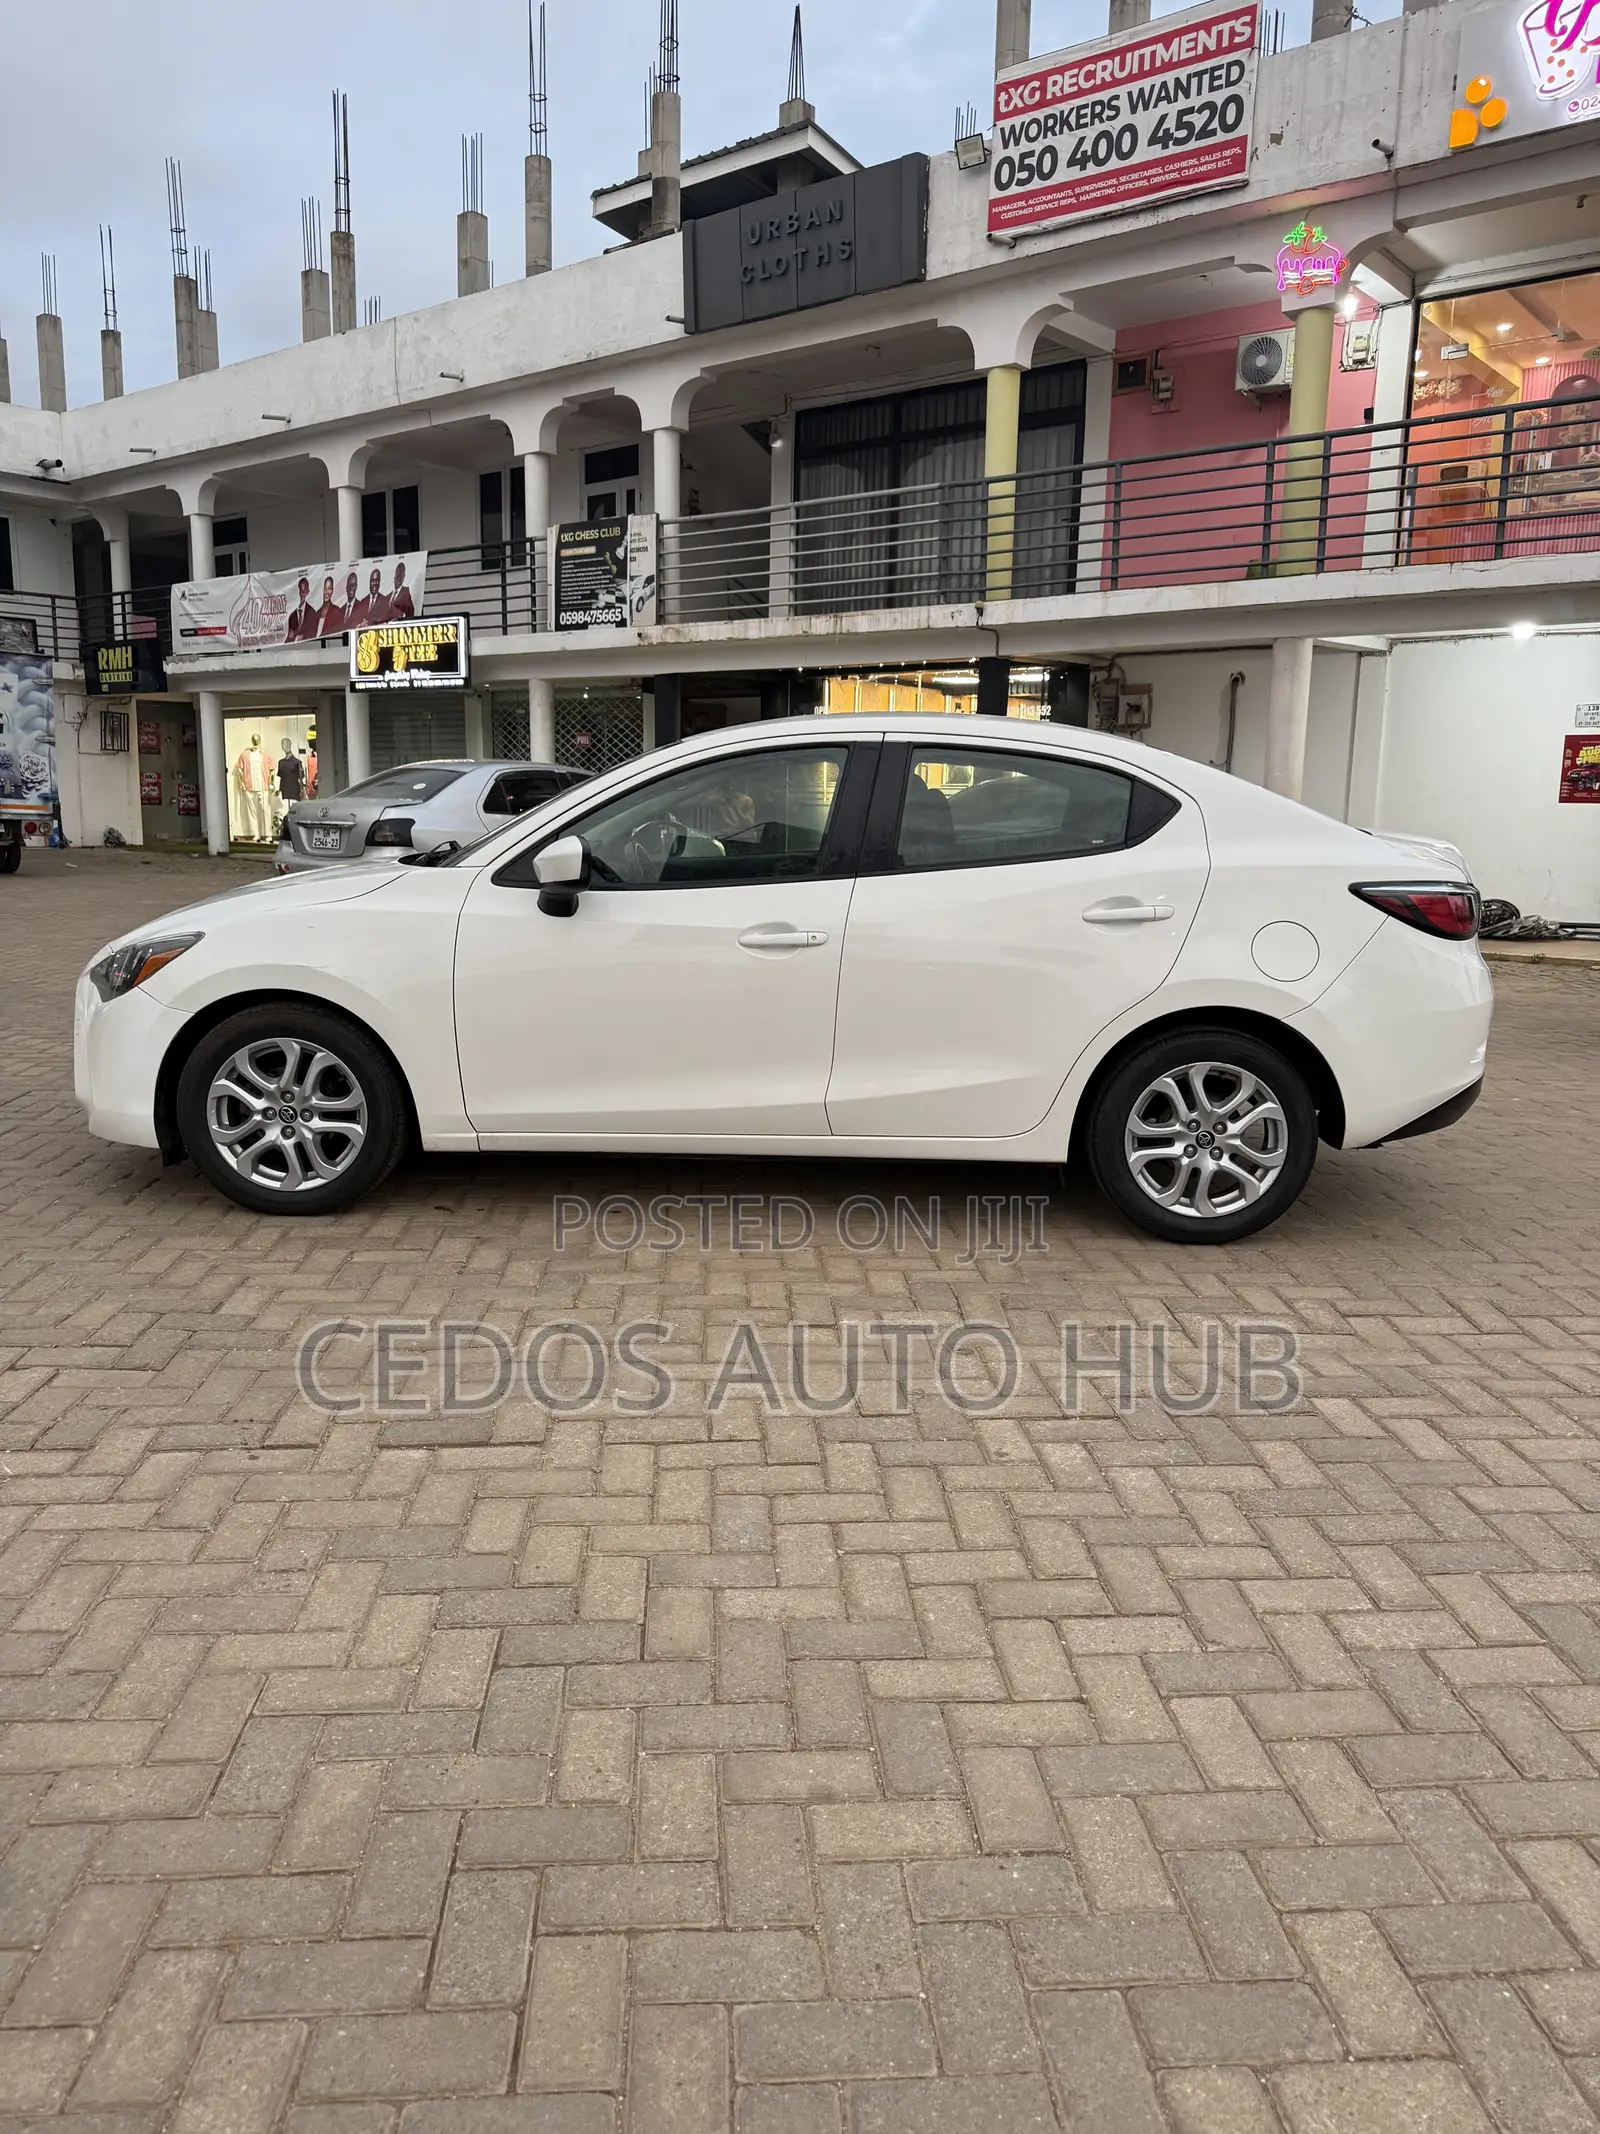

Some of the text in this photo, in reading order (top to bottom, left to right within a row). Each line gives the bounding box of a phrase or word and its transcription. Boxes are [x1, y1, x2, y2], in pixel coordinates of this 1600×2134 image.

[998, 15, 1252, 113] tXG RECRUITMENTS
[1000, 59, 1246, 150] WORKERS WANTED
[994, 93, 1245, 191] 050 400 4520
[992, 146, 1242, 213] MANAGERS, ACCOUNTANTS, SUPERVISORS, SECRETARIES, CASHIERS, SALES REPS,
[1000, 158, 1232, 220] CUSTOMER SERVICE REPS, MARKETING OFFICERS, DRIVERS, CLEANERS ECT.
[748, 198, 843, 246] URBAN
[740, 236, 852, 285] CLOTHS
[560, 526, 621, 543] tXG CHESS CLUB
[378, 623, 456, 648] SHIMMER
[559, 607, 622, 625] 0598475665
[97, 645, 133, 670] RMH
[100, 671, 132, 683] CLOTHING
